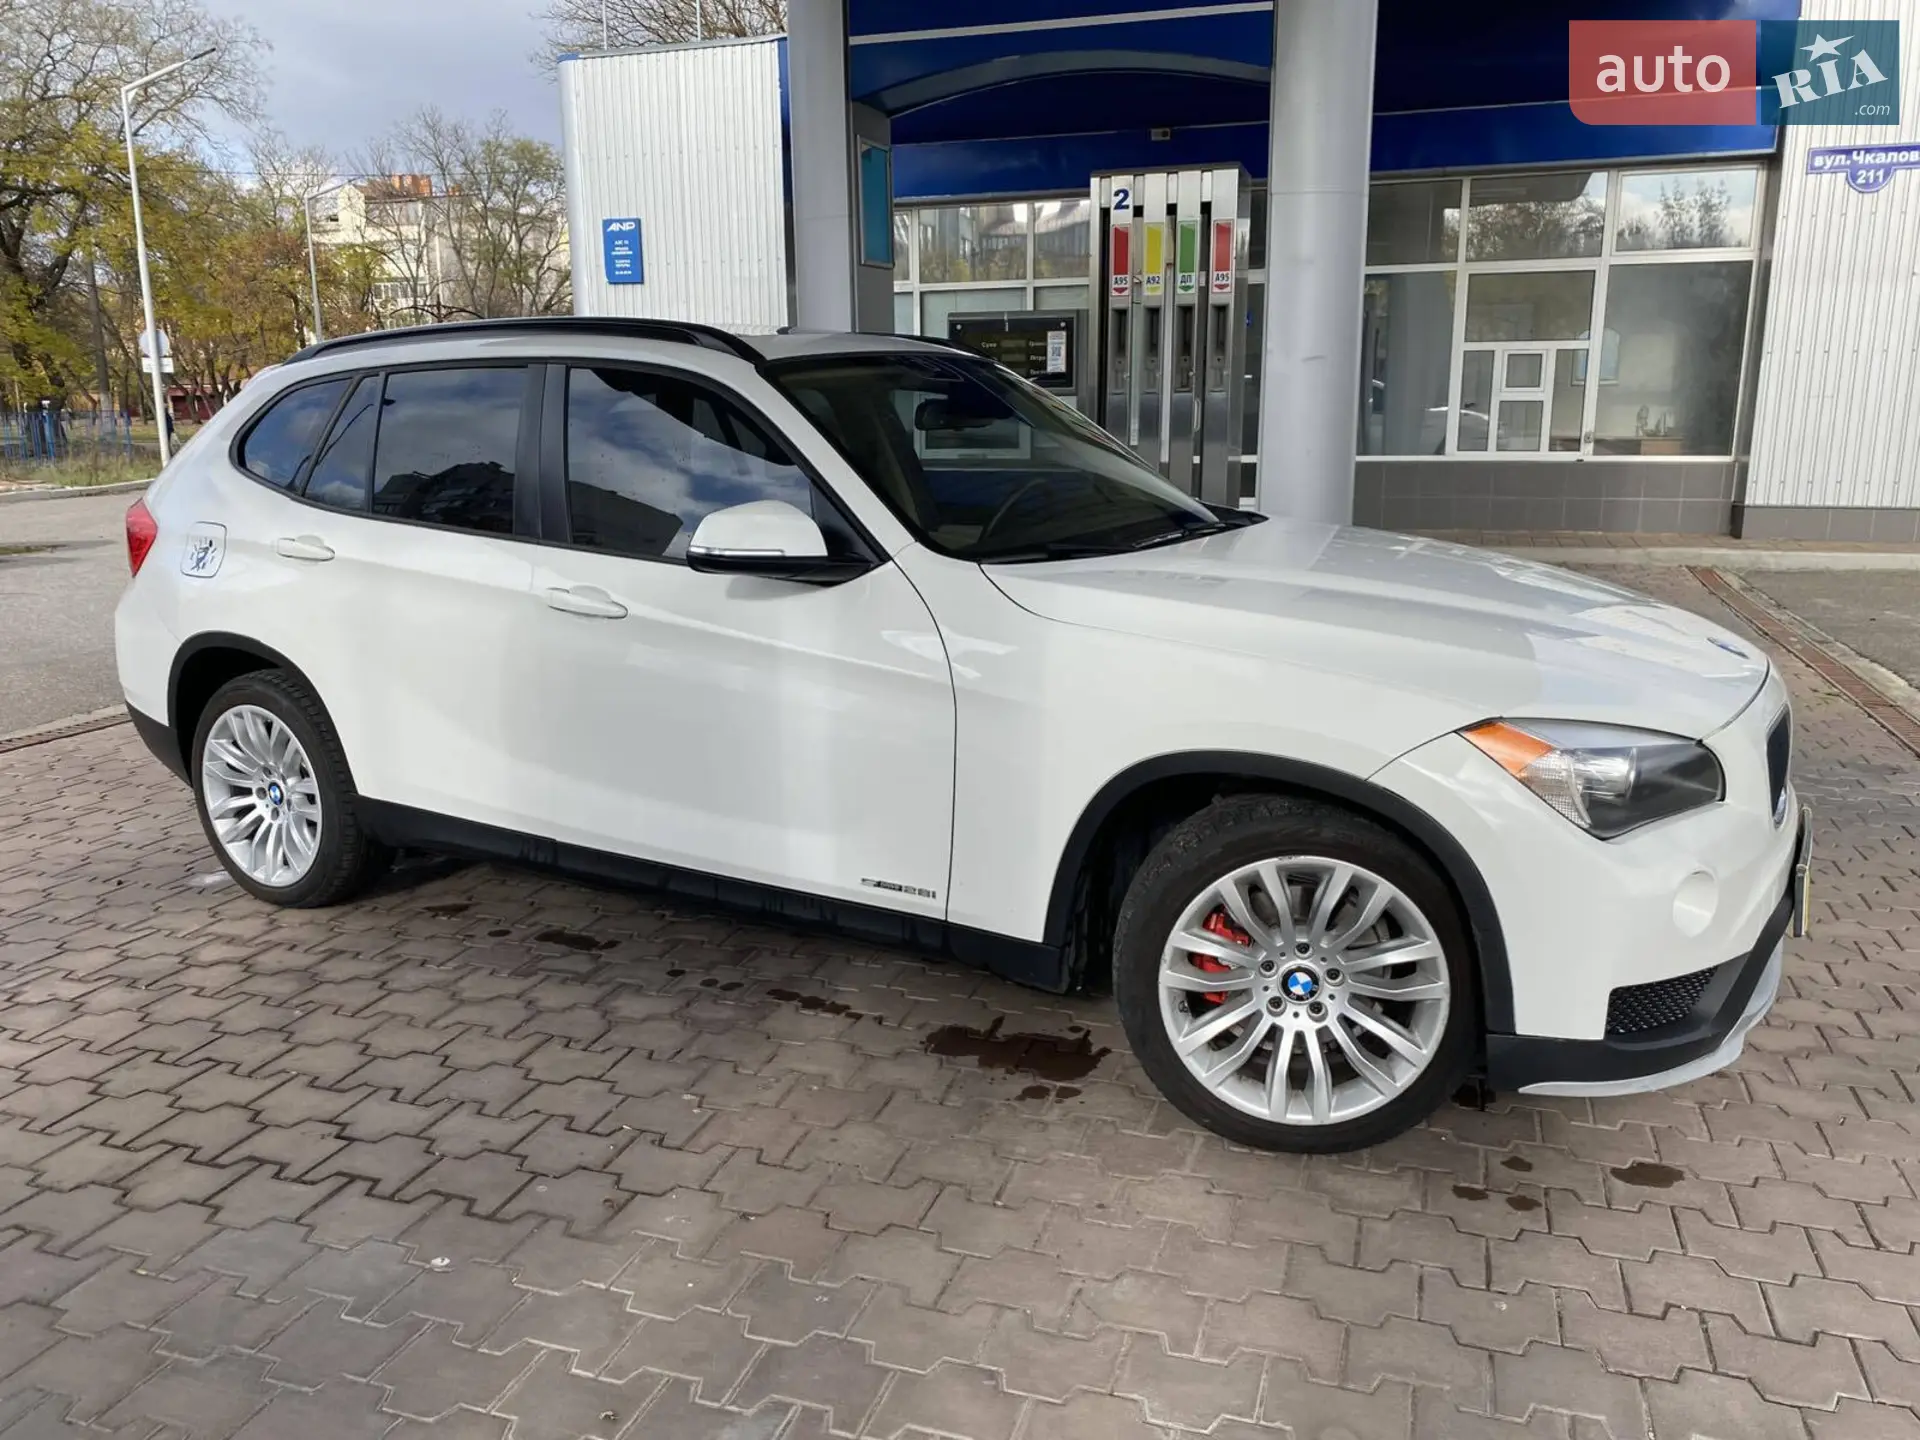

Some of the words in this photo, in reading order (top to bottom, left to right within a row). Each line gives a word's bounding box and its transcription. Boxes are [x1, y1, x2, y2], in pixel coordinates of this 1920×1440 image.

[1856, 169, 1885, 184] 211
[1113, 188, 1130, 211] 2
[606, 221, 636, 232] ANP
[1180, 274, 1193, 284] ДП
